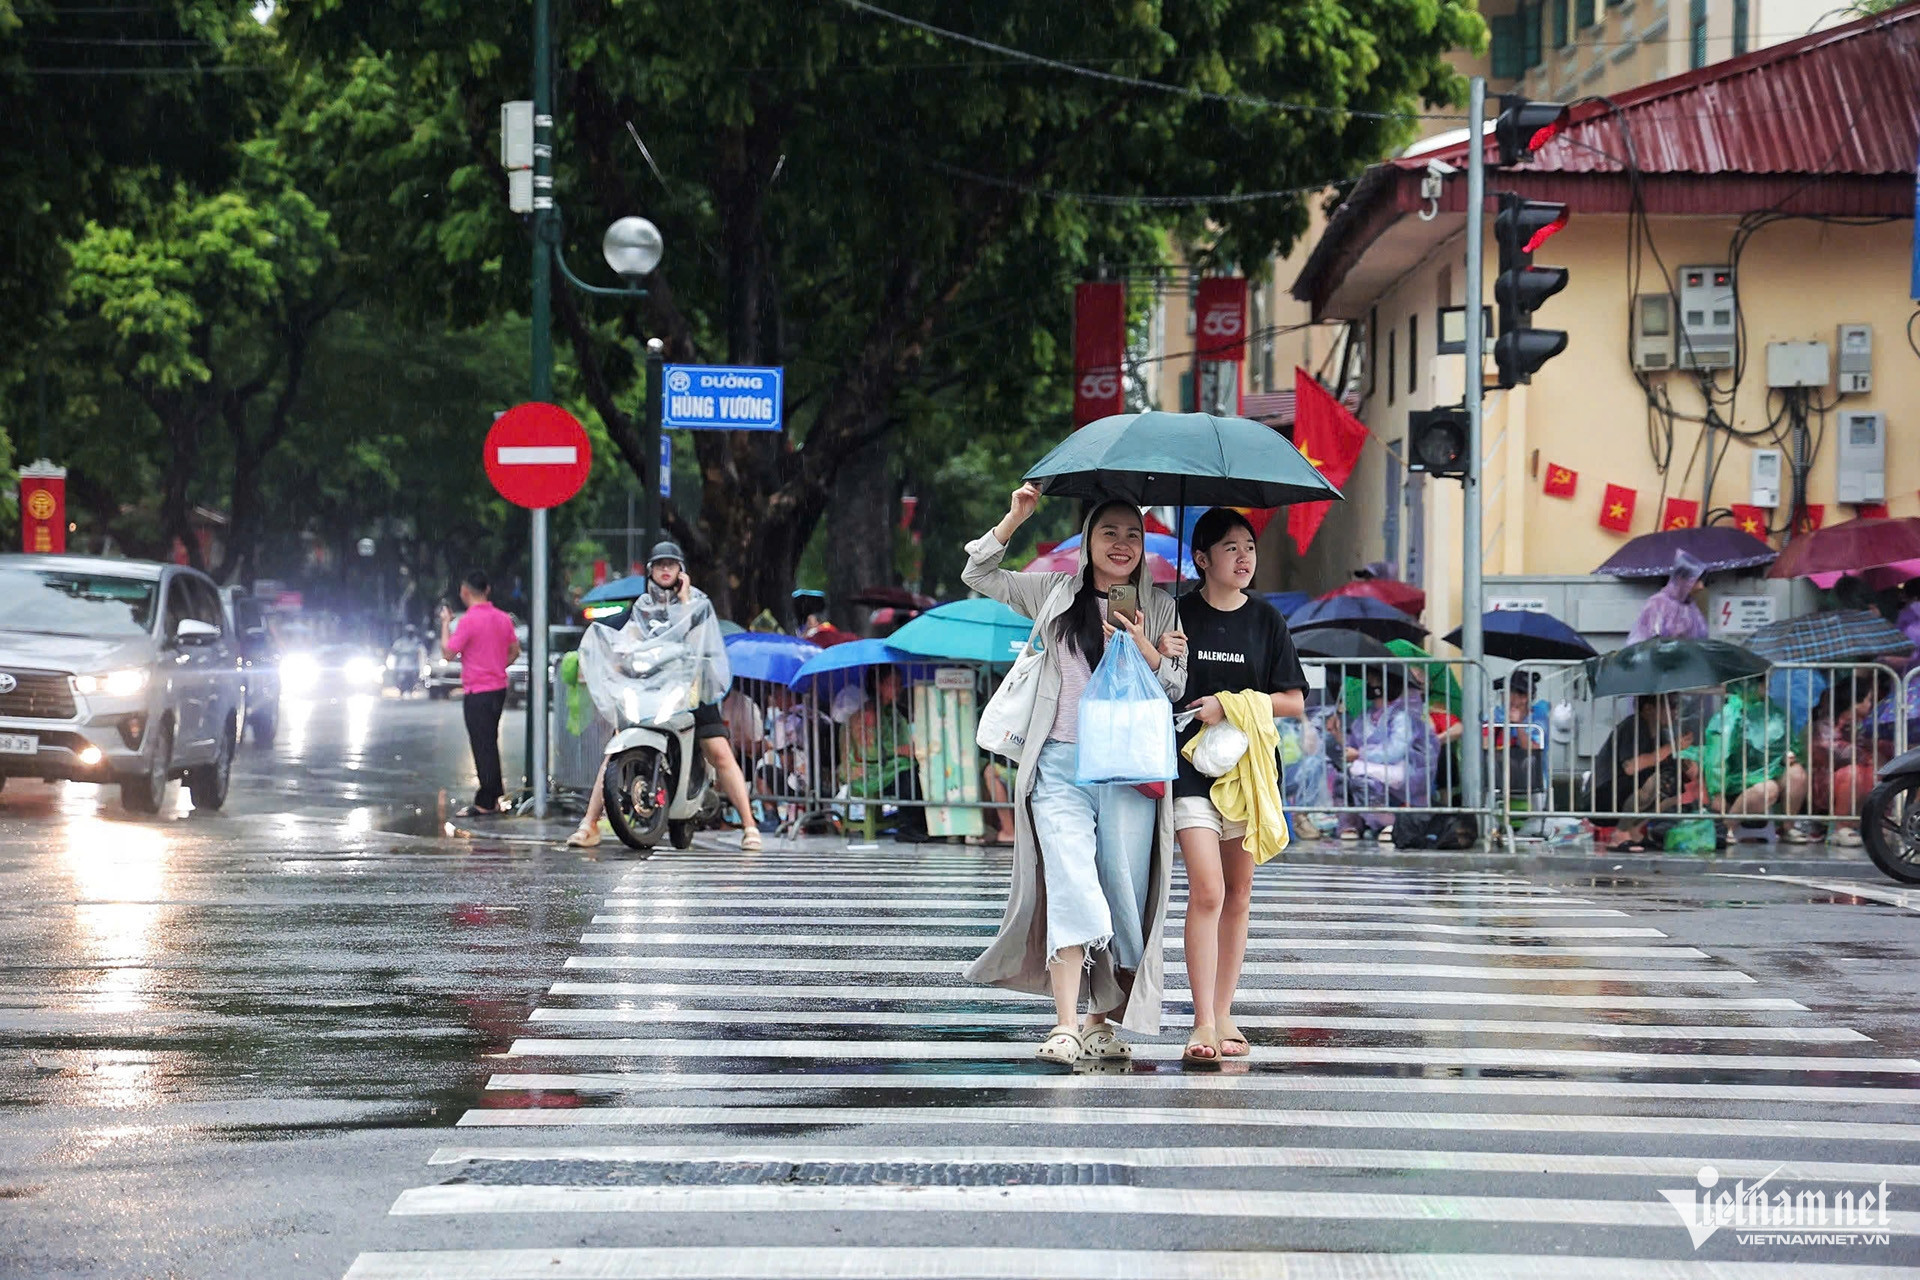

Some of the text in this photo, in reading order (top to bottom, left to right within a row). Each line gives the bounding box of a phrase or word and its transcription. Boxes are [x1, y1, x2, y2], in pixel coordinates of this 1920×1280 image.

[700, 372, 763, 389] ĐƯỜNG
[671, 391, 714, 418] HÙNG
[1197, 650, 1245, 663] BALENCIAGA
